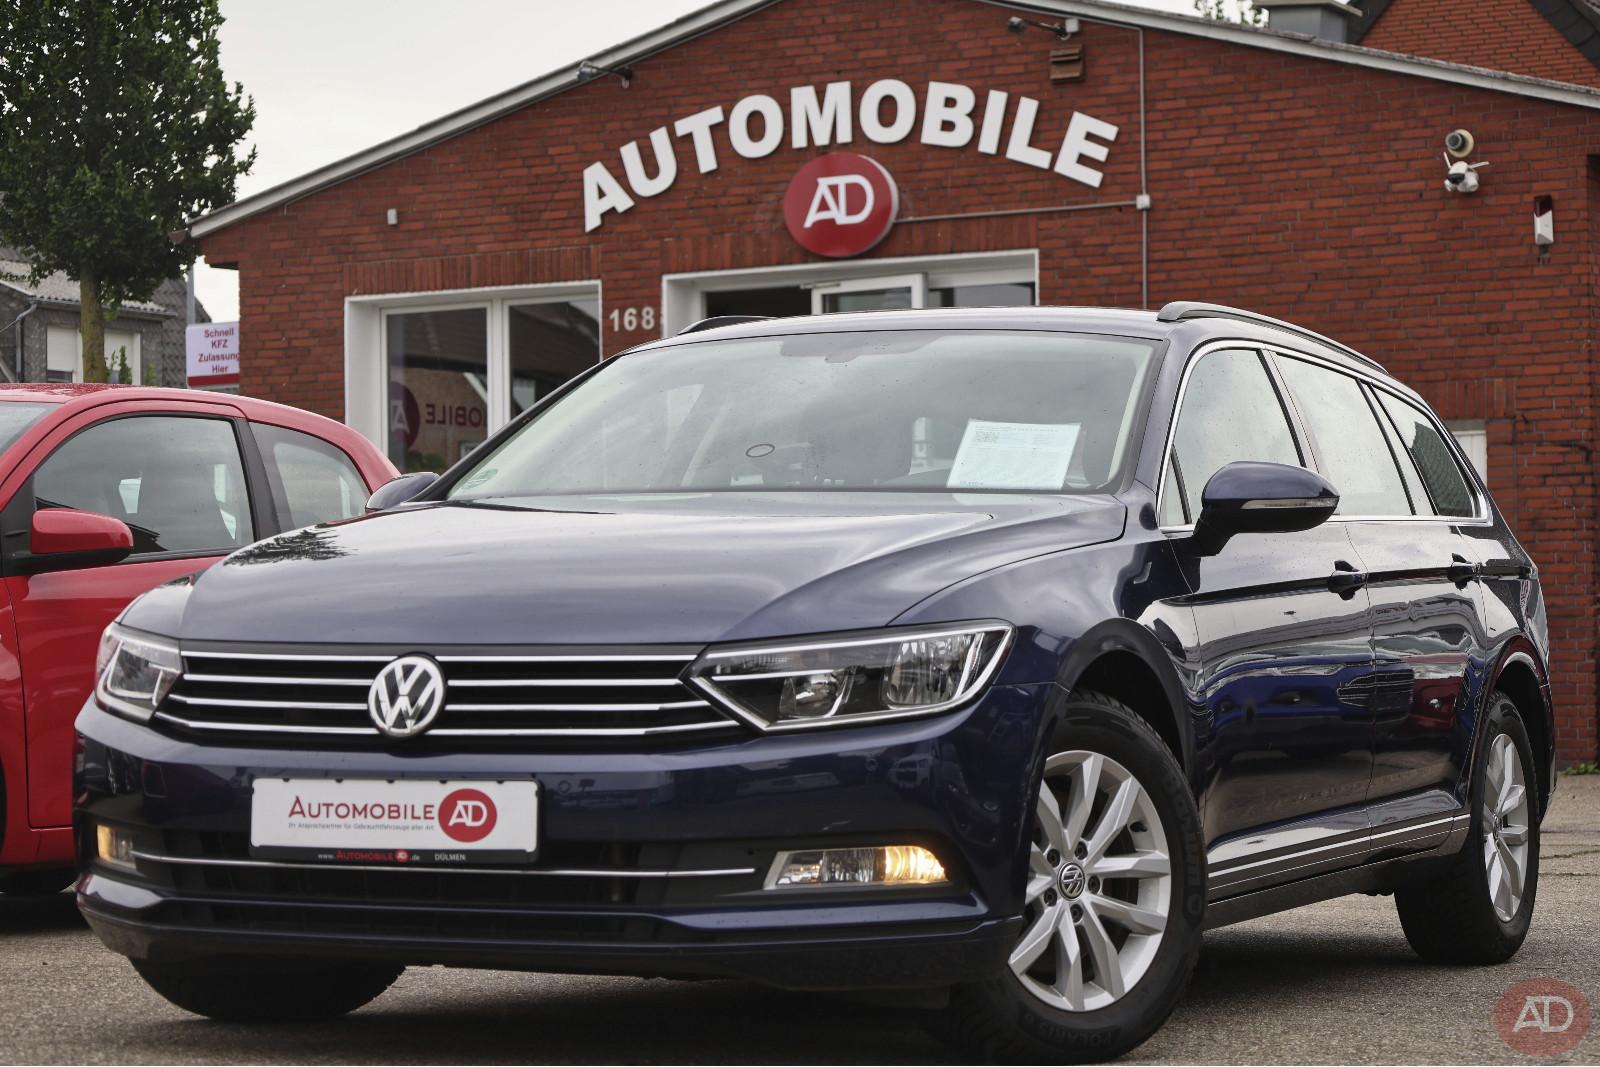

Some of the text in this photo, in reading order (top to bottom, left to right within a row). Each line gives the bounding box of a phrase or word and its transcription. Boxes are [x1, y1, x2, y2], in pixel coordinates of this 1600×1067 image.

[583, 79, 1119, 233] AUTOMOBILE
[804, 174, 875, 229] AD
[204, 328, 234, 338] Schnell
[609, 306, 655, 332] 168
[211, 339, 228, 349] KFZ
[211, 365, 228, 373] Hier
[370, 658, 441, 736] VW
[288, 795, 488, 827] AUTOMOBILE AD
